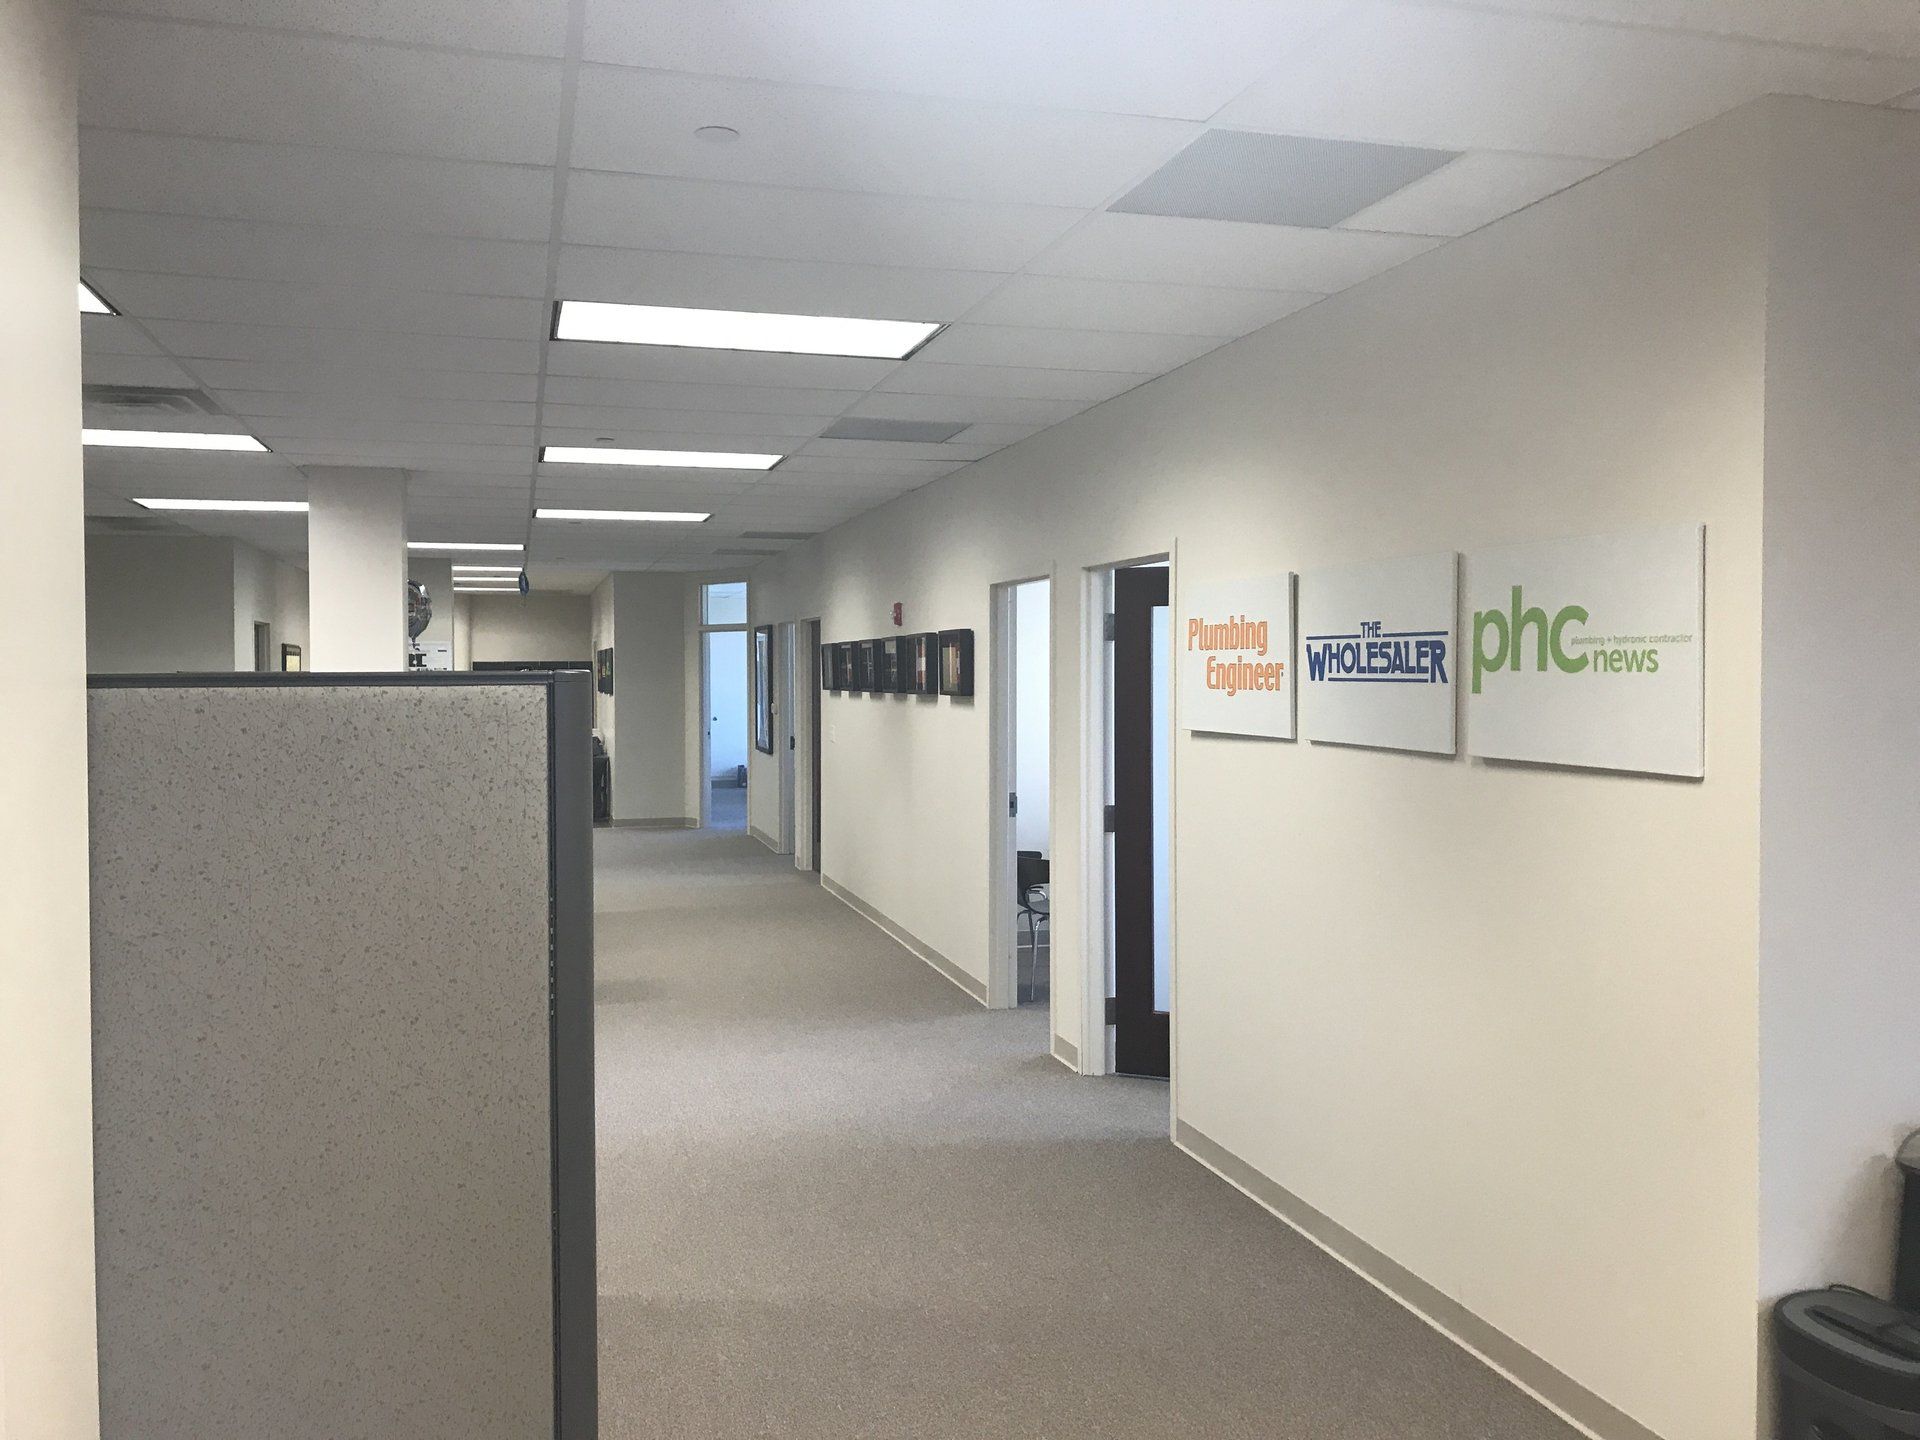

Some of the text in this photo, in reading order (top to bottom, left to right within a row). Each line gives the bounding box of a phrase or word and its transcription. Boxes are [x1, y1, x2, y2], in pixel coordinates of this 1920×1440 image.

[1188, 615, 1268, 656] Plumbing
[1360, 621, 1381, 638] THE
[1472, 585, 1589, 694] phc
[1571, 635, 1605, 646] plumbing
[1613, 635, 1647, 645] hydronic
[1649, 634, 1693, 643] contractor
[1206, 655, 1284, 697] Engineer
[1306, 640, 1449, 683] WHOLESALER
[1593, 649, 1659, 673] news
